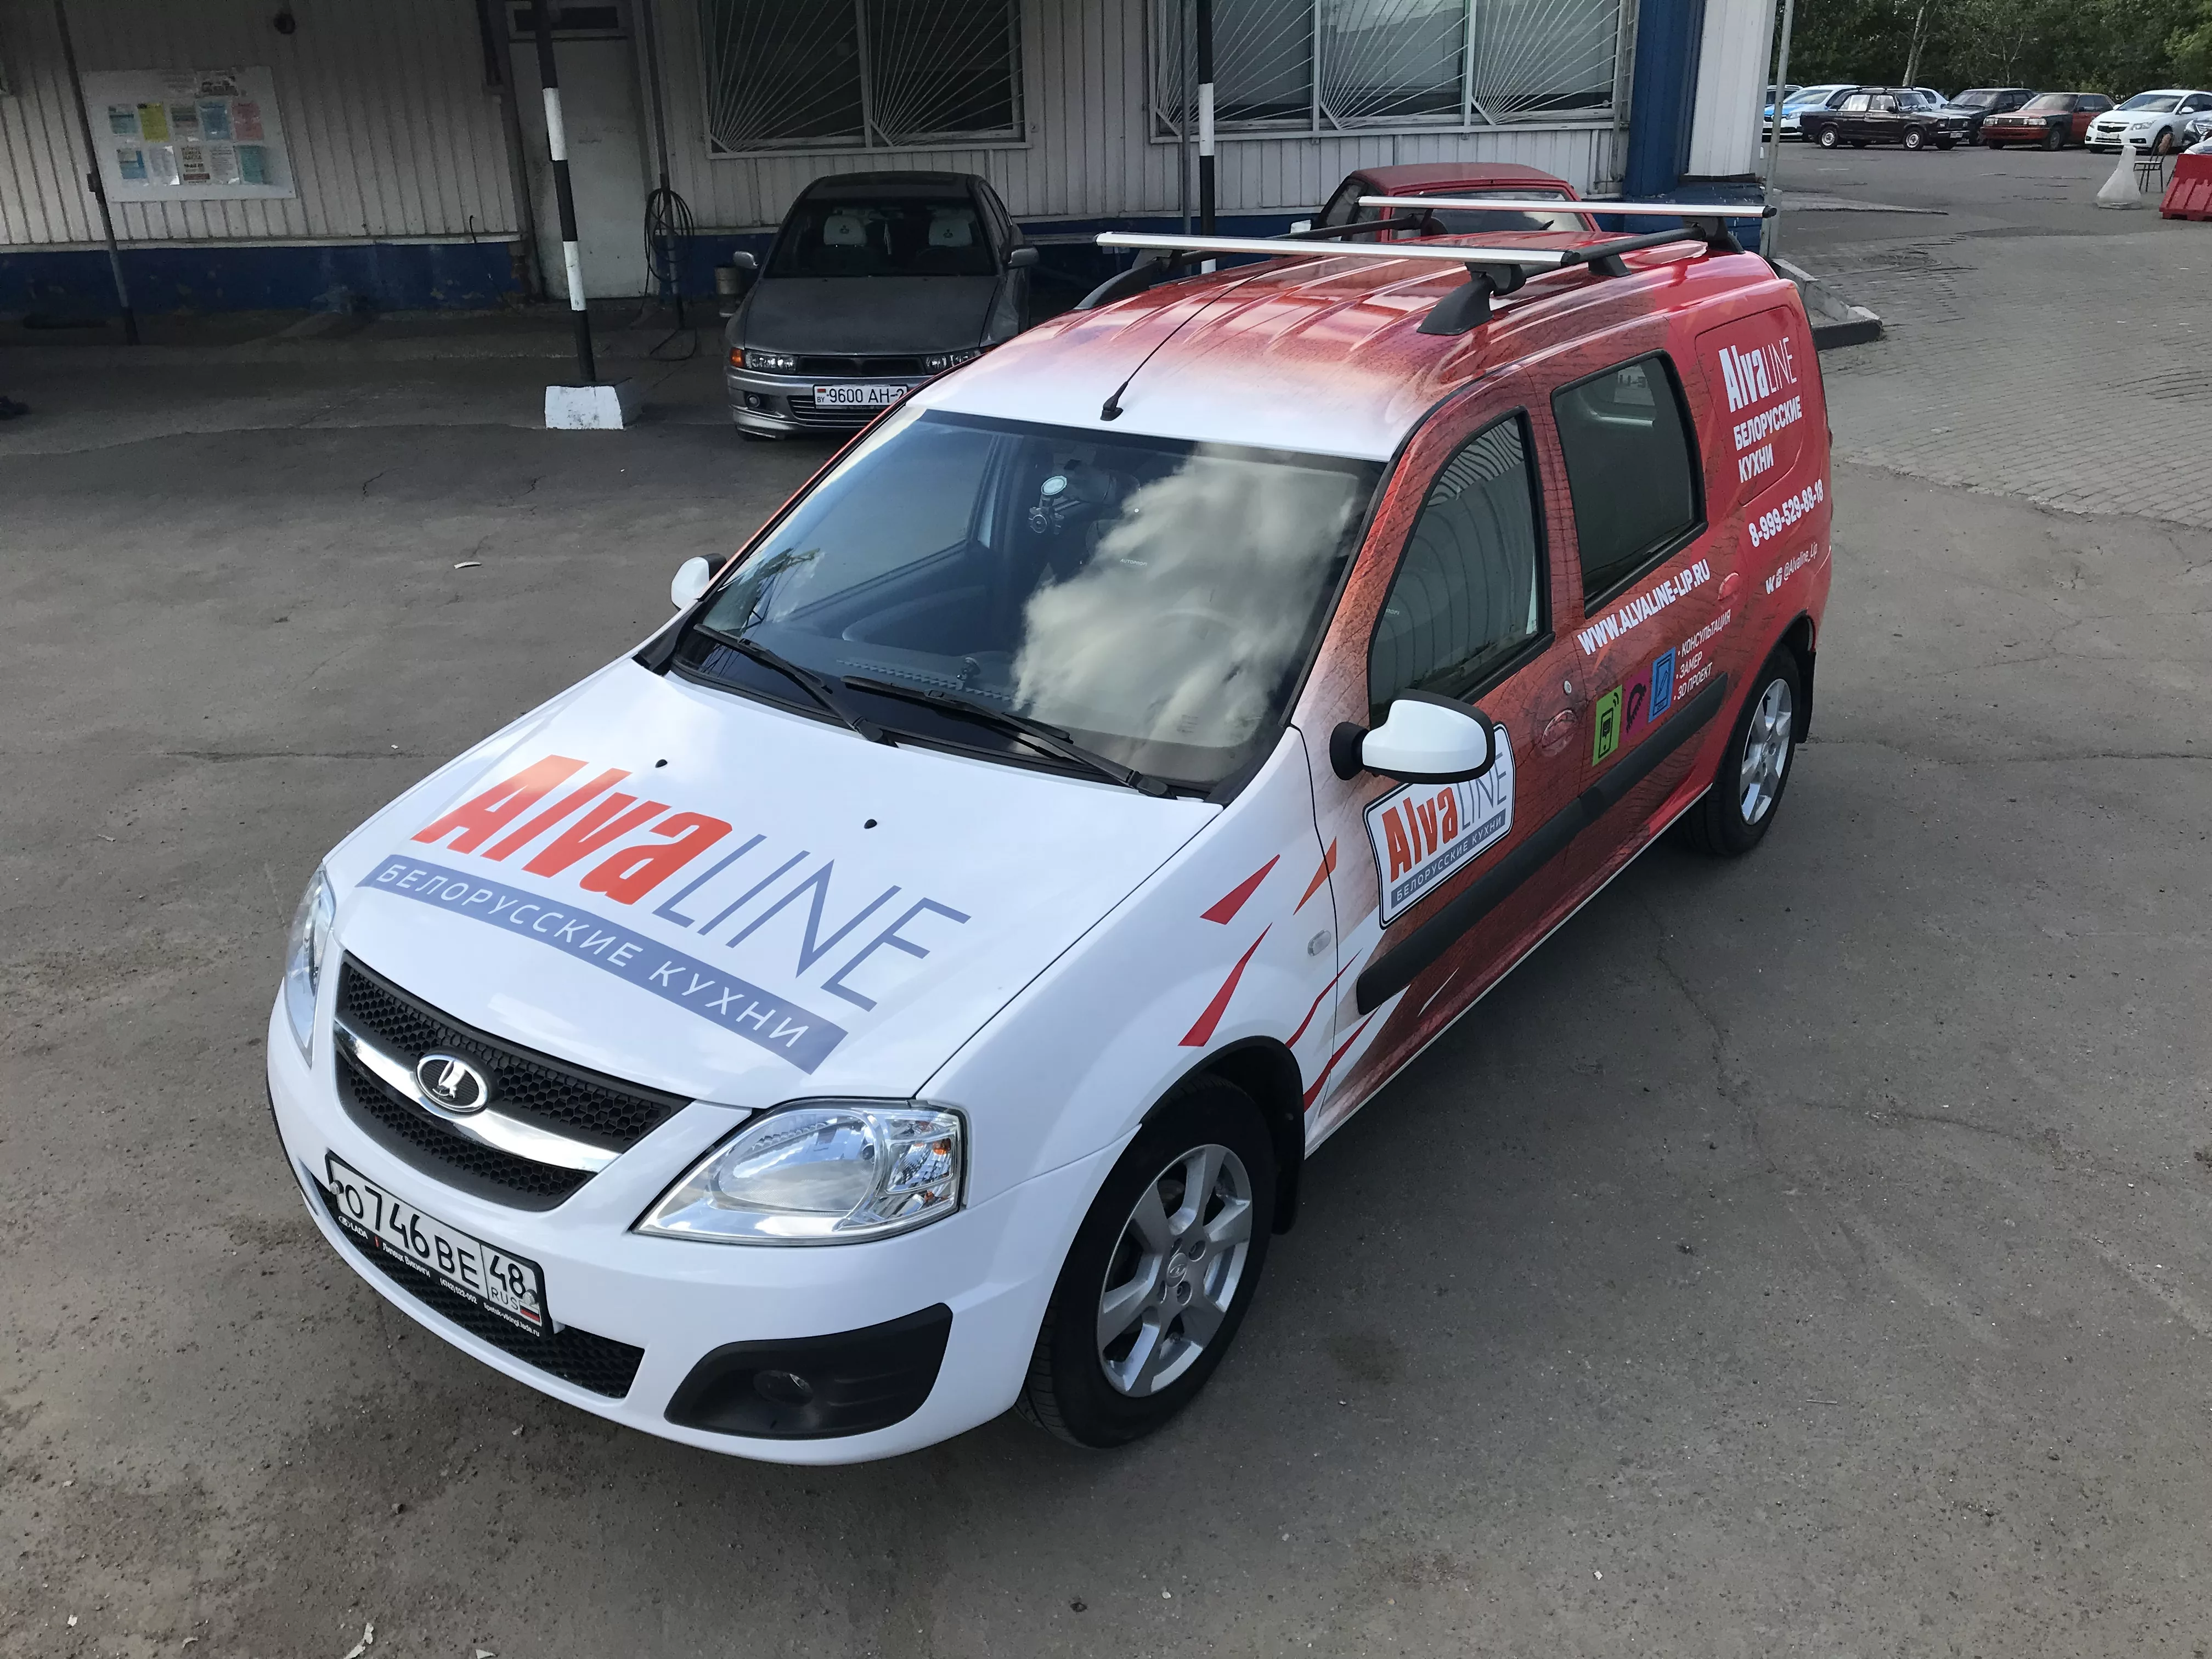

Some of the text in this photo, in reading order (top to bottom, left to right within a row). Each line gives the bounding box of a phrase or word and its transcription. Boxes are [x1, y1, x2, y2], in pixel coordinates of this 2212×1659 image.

[829, 388, 863, 403] 9600
[1718, 336, 1797, 413] AlvaLINE
[1733, 395, 1802, 451] БЕЛОРУССКИЕ
[1738, 443, 1774, 483] КУХНИ
[1748, 478, 1824, 547] 8-999-529-88-18
[1577, 558, 1711, 656] WWW.ALVALINE-LIP.RU
[1681, 608, 1731, 658] КОНСУЛЬТАЦИЯ
[1677, 662, 1713, 700] 3D ПРОЕКТ
[1679, 651, 1703, 679] ЗАМЕР
[1381, 752, 1507, 883] AlvaLINE
[410, 754, 972, 1012] AlvaLINE
[1396, 816, 1502, 901] БЕЛОРУССКИЕ КУХНИ
[377, 864, 810, 1048] БЕЛОРУССКИЕ КУХНИ
[350, 1223, 368, 1239] LADA
[489, 1255, 526, 1299] 48
[491, 1286, 518, 1311] RUS
